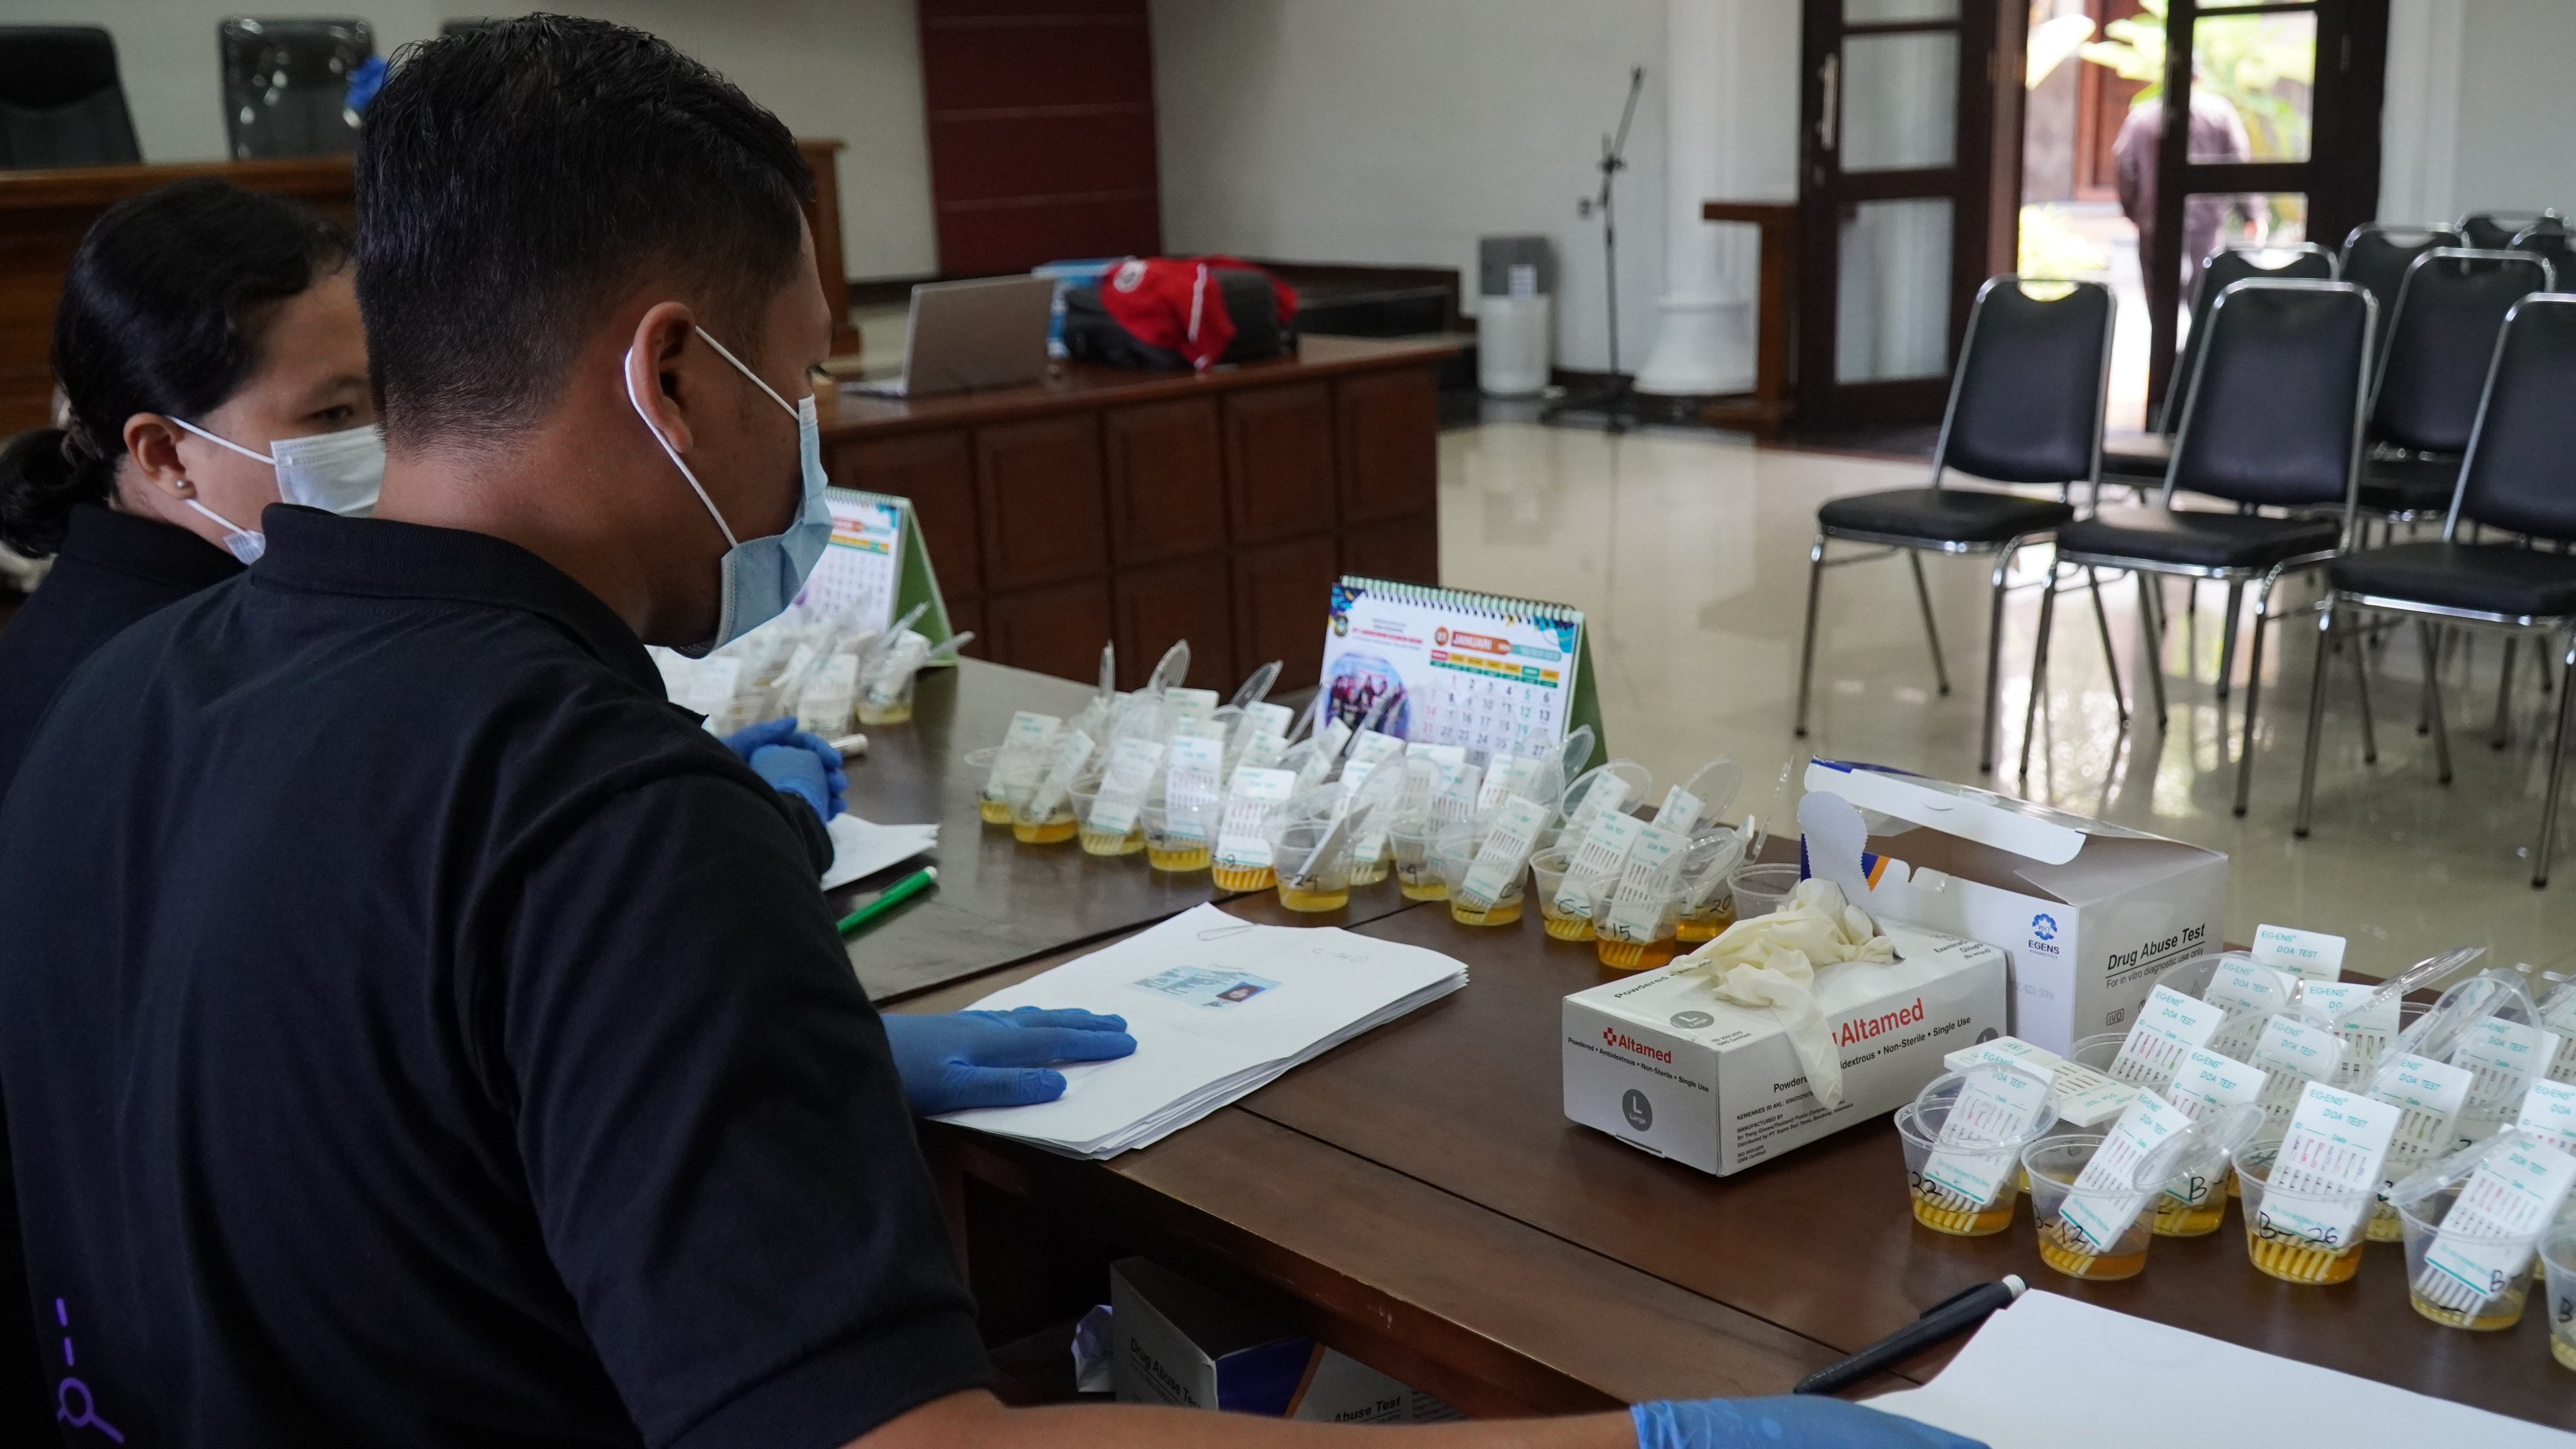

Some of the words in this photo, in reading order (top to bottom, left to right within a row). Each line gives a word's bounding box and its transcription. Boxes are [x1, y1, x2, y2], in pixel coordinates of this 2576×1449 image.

[1469, 678, 1476, 690] 2
[1506, 685, 1513, 695] 4
[1543, 692, 1550, 703] 6
[1539, 709, 1550, 722] 13
[1476, 732, 1488, 744] 24
[2029, 940, 2060, 955] EGENS
[2108, 950, 2138, 970] Drug
[2140, 936, 2178, 959] Abuse
[2182, 922, 2205, 944] Test
[2276, 946, 2294, 955] DOA
[2299, 949, 2318, 958] TEST
[2107, 979, 2118, 989] For
[2120, 976, 2126, 984] in
[2128, 971, 2142, 982] vitro
[2144, 957, 2177, 976] diagnostic
[2178, 952, 2190, 964] use
[2191, 947, 2204, 958] only
[2287, 965, 2302, 973] Date
[1614, 976, 1669, 998] Powdered
[2233, 978, 2248, 988] DOA
[2252, 983, 2269, 993] TEST
[1841, 997, 1924, 1047] Altamed
[2109, 1012, 2122, 1023] IVD
[2162, 1009, 2177, 1020] DOA
[2179, 1015, 2196, 1026] TEST
[1883, 1033, 1926, 1055] Non-Sterile
[1933, 1022, 1956, 1037] Single
[1957, 1016, 1971, 1028] Use
[1618, 1035, 1672, 1064] Altamed
[2281, 1039, 2297, 1050] DOA
[2300, 1046, 2318, 1057] TEST
[2509, 1042, 2530, 1053] TEST
[1568, 1037, 1594, 1052] Powdered
[1599, 1048, 1636, 1066] Ambidextrous
[1641, 1063, 1673, 1079] Non-Sterile
[1679, 1076, 1696, 1088] Single
[1698, 1082, 1709, 1092] Use
[1774, 1076, 1808, 1093] Powdere
[2009, 1078, 2026, 1090] TEST
[2199, 1070, 2216, 1082] DOA
[2219, 1078, 2238, 1089] TEST
[2399, 1073, 2417, 1085] DOA
[2421, 1079, 2441, 1091] TEST
[1632, 1095, 1643, 1115] L
[1737, 1106, 1765, 1121] KEMENKES
[2550, 1103, 2571, 1115] DOA
[1737, 1116, 1776, 1134] MANUFACTURED
[2140, 1113, 2153, 1125] DOA
[2153, 1123, 2167, 1135] TEST
[2323, 1109, 2343, 1120] DOA
[2347, 1116, 2369, 1128] TEST
[1737, 1136, 1762, 1149] Distributed
[1131, 1337, 1151, 1370] Drug
[1153, 1361, 1181, 1395] Abuse
[1335, 1407, 1372, 1422] Abuse
[1376, 1396, 1401, 1412] Test
